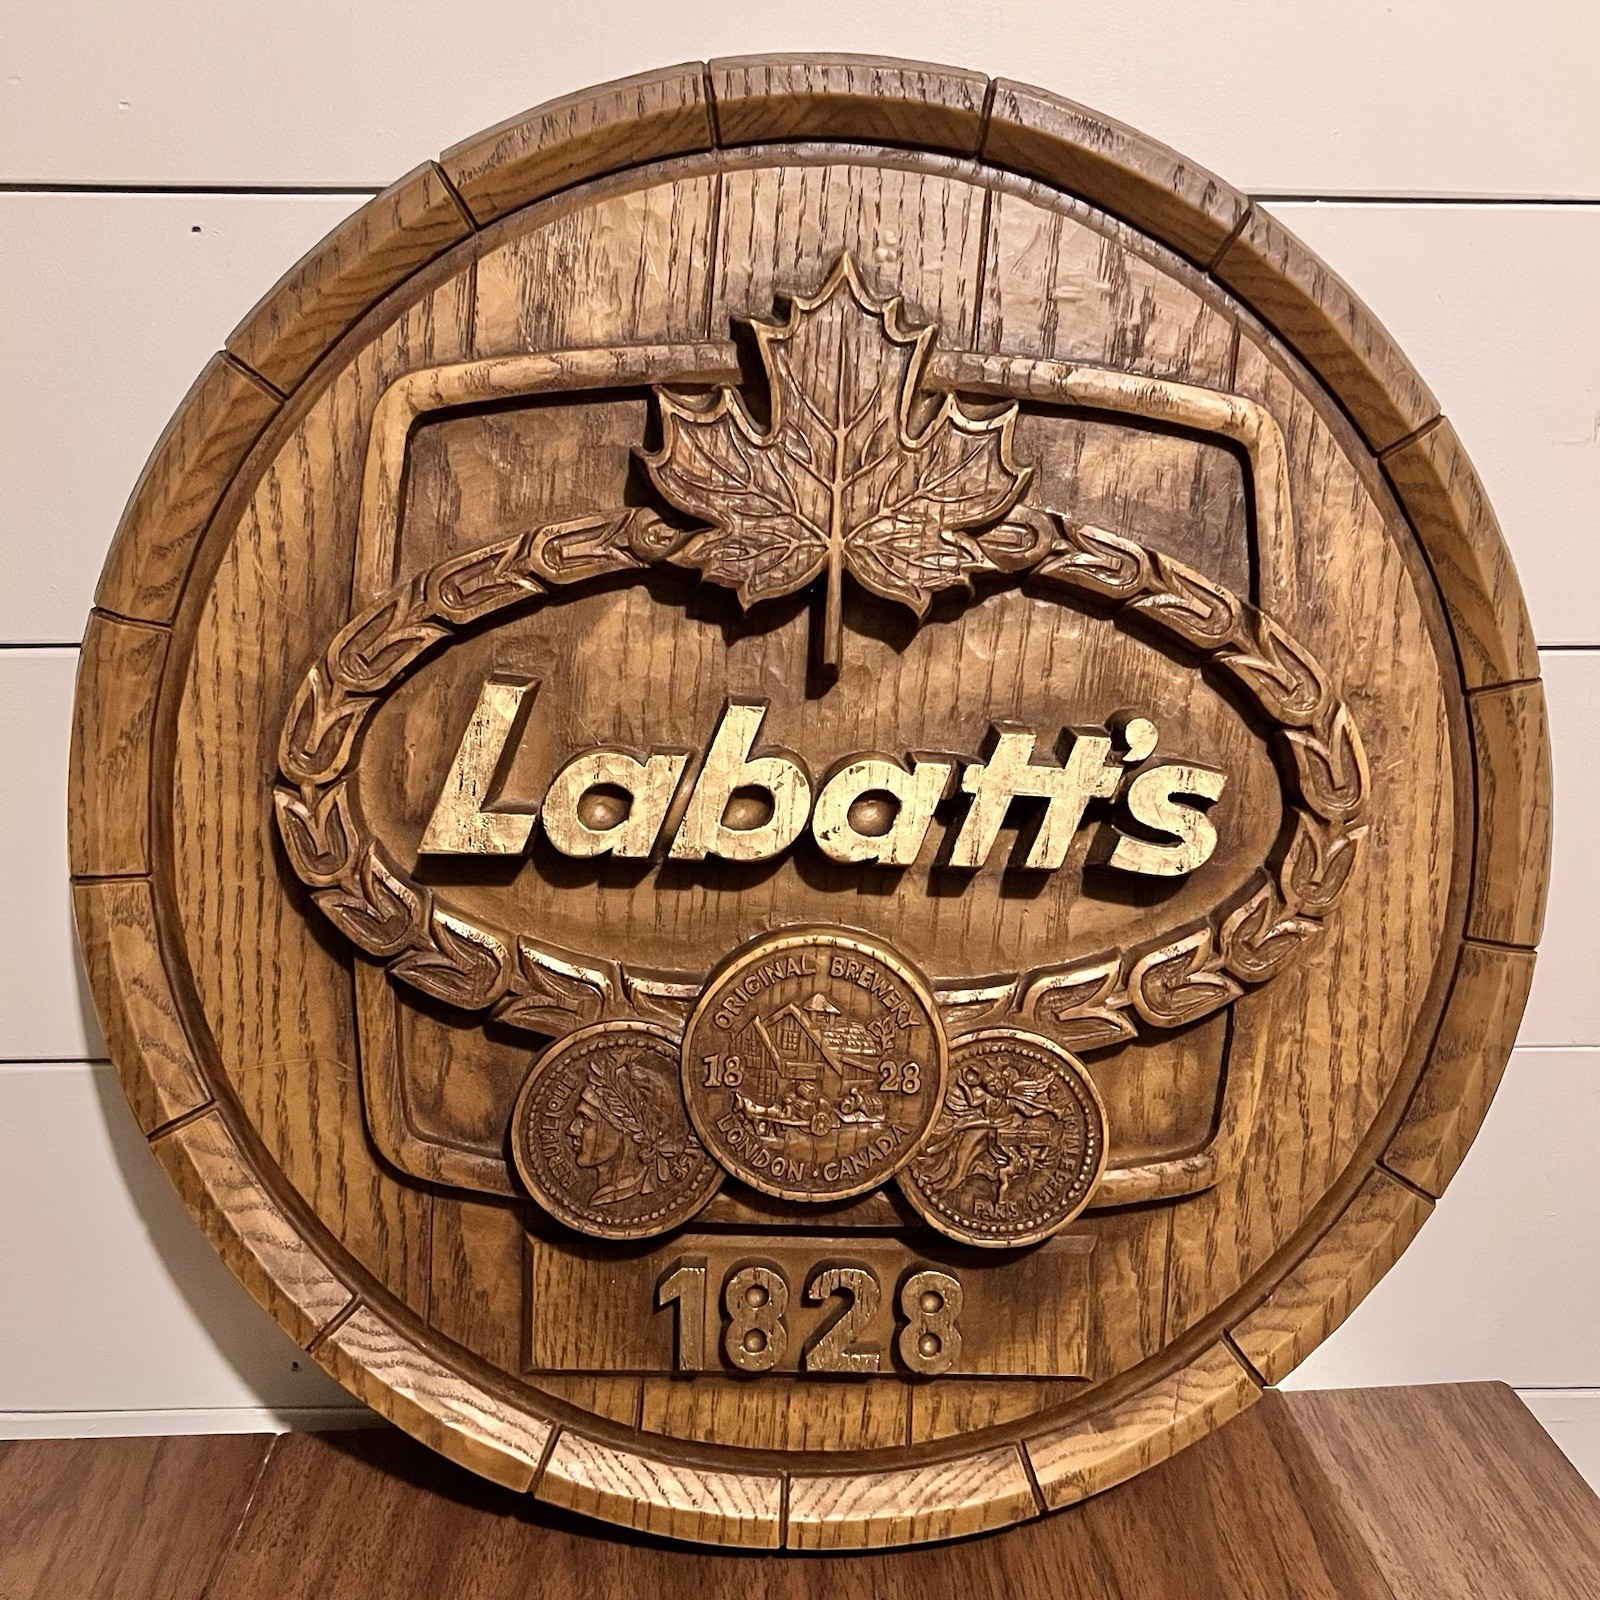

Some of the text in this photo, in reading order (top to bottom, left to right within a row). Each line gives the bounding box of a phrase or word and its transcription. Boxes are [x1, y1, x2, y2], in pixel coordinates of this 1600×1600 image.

[416, 675, 1229, 880] Labatt's
[713, 955, 920, 1030] ORIGINAL BREWERY
[702, 1054, 922, 1094] 18 28
[715, 1111, 910, 1182] LONDON CANADA
[972, 1200, 1020, 1219] PARIS
[655, 1261, 966, 1376] 1828
